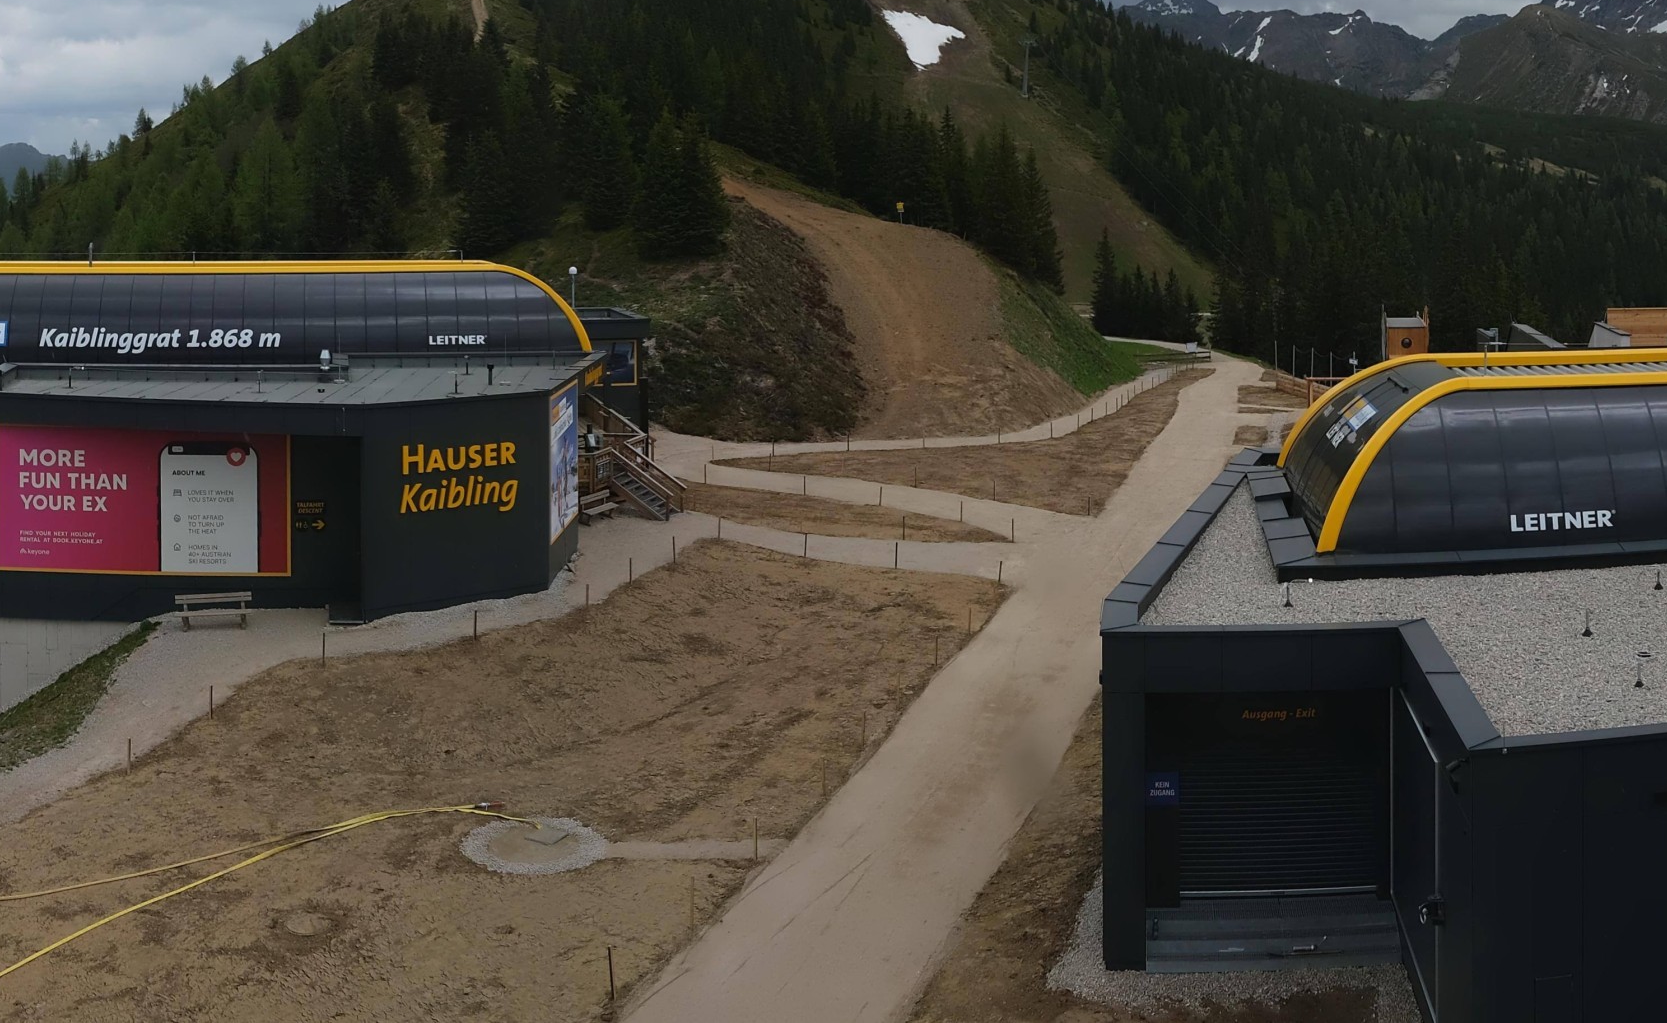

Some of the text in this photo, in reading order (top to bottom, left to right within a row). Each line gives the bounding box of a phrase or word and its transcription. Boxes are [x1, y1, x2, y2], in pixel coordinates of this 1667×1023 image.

[39, 327, 281, 354] Kaiblinggrat 1.868 m
[428, 335, 486, 345] LEITNER
[19, 448, 86, 467] MORE
[402, 441, 516, 475] HAUSER
[19, 471, 127, 490] FUN THAN
[20, 494, 108, 512] YOUR EX
[400, 475, 518, 514] Kaibling
[1510, 509, 1614, 532] LEITNER
[1241, 709, 1287, 722] Ausgang
[1296, 708, 1316, 719] Exit
[1150, 789, 1175, 797] ZUGANG
[1155, 781, 1170, 789] KEIN
